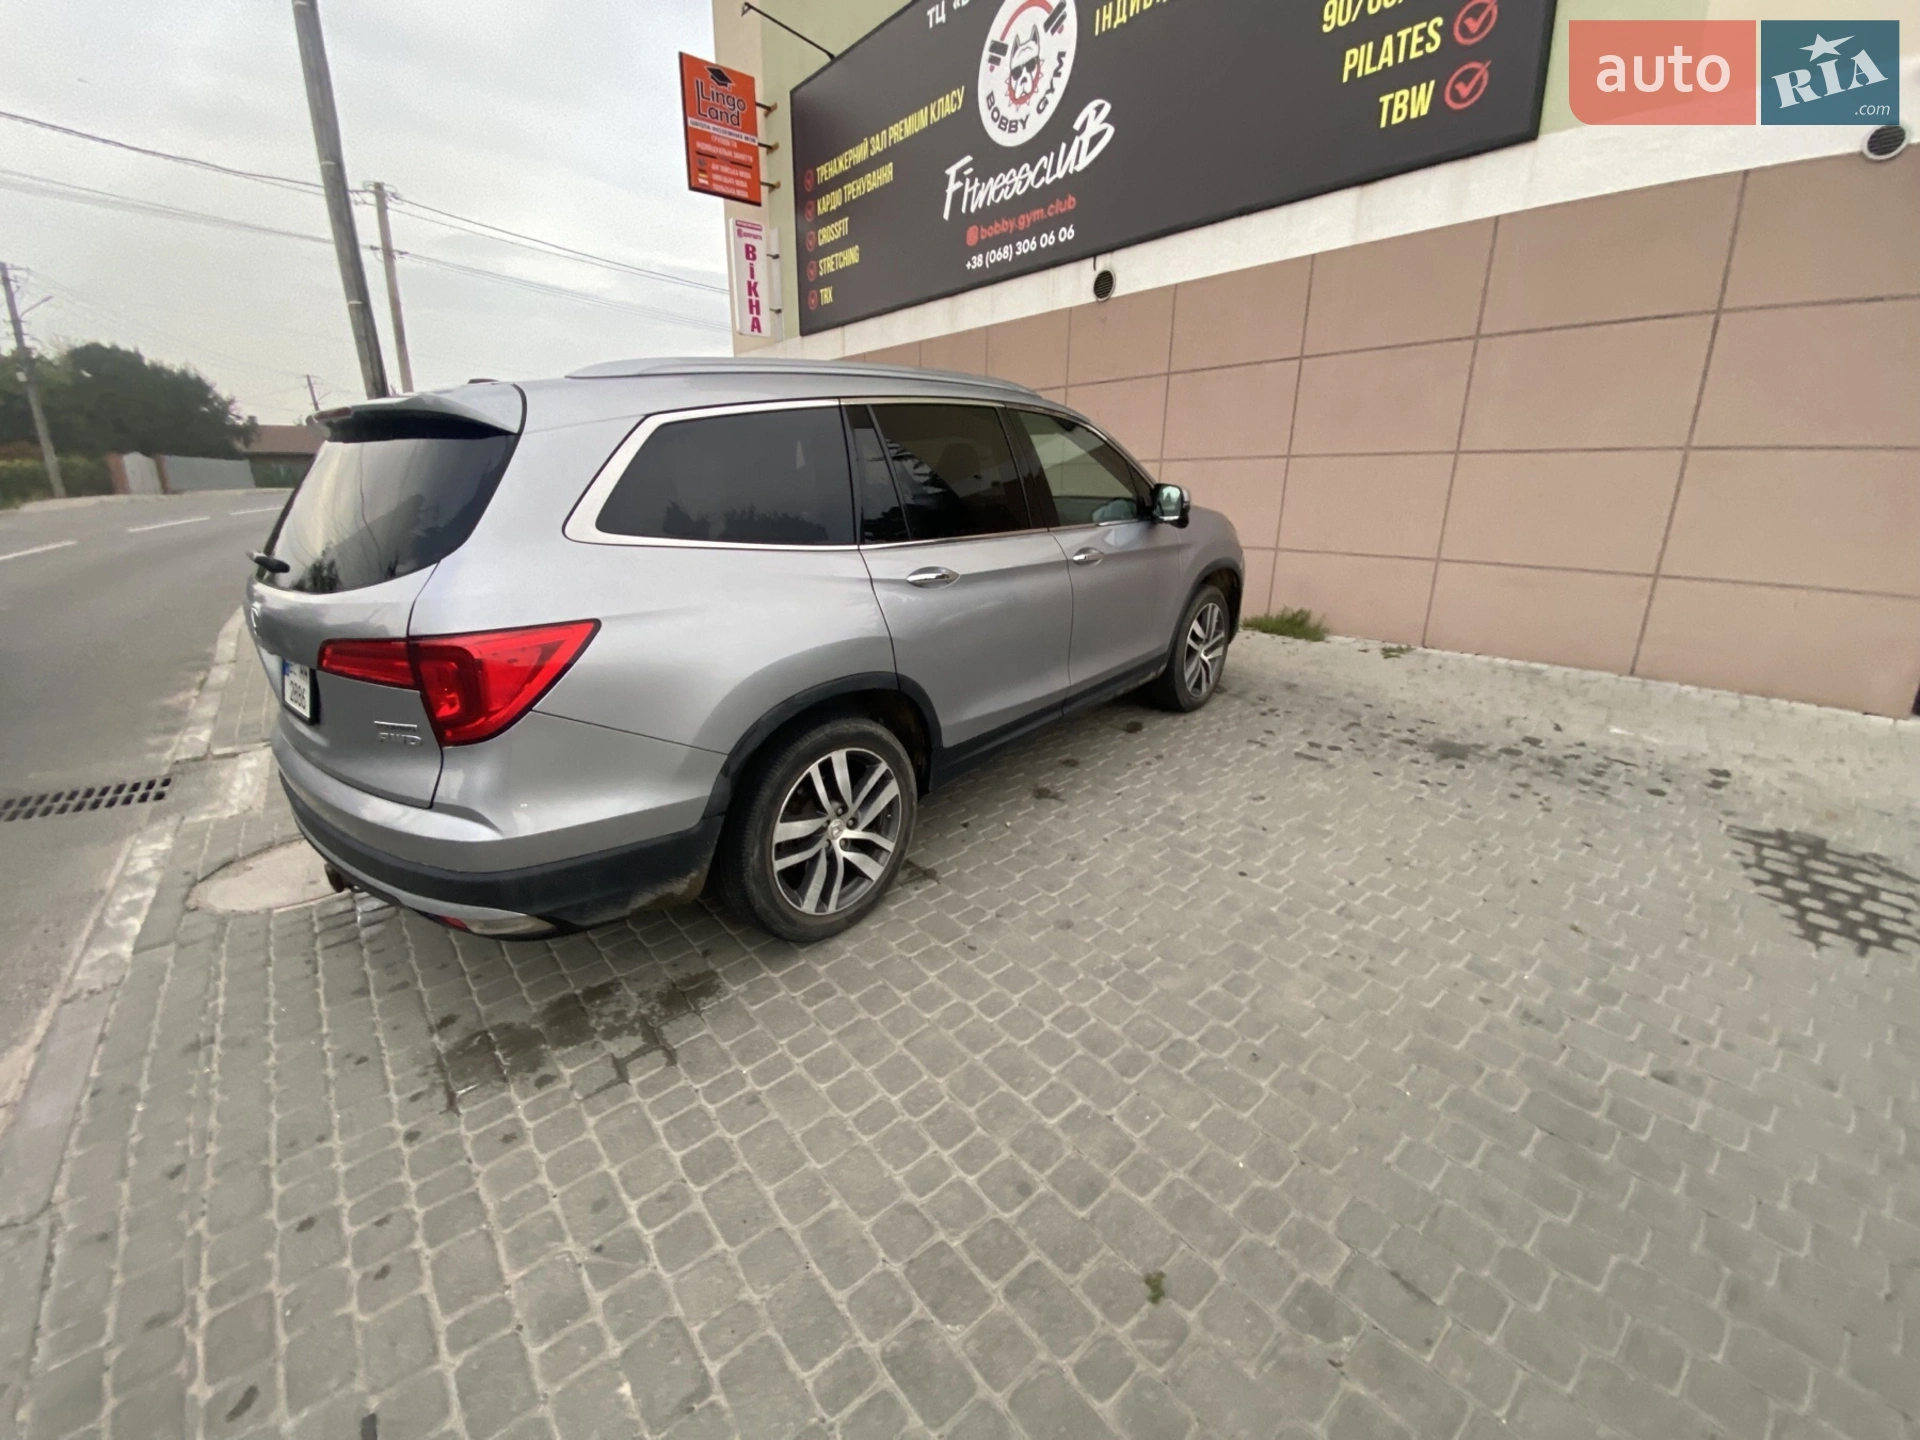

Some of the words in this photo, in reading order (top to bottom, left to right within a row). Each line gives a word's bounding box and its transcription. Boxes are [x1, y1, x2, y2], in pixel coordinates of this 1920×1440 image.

[927, 0, 946, 29] ТЦ
[1342, 17, 1444, 83] PILATES
[700, 79, 746, 112] Lingo
[986, 90, 1030, 133] BOBBY
[1036, 51, 1066, 115] GYM
[1379, 80, 1435, 128] TBW
[816, 137, 869, 185] ТРЕНАЖЕРНИЙ
[869, 129, 887, 158] ЗАЛ
[888, 105, 928, 147] PREMIUM
[929, 85, 965, 125] КЛАСУ
[843, 162, 894, 204] ТРЕНУВАННЯ
[818, 217, 849, 247] CROSSFIT
[965, 255, 983, 270] +38
[985, 244, 1013, 269] (068)
[1015, 238, 1037, 256] 306
[1040, 230, 1056, 249] 06
[1058, 223, 1075, 242] 06
[819, 245, 860, 277] STRETCHING
[819, 285, 833, 306] TRX
